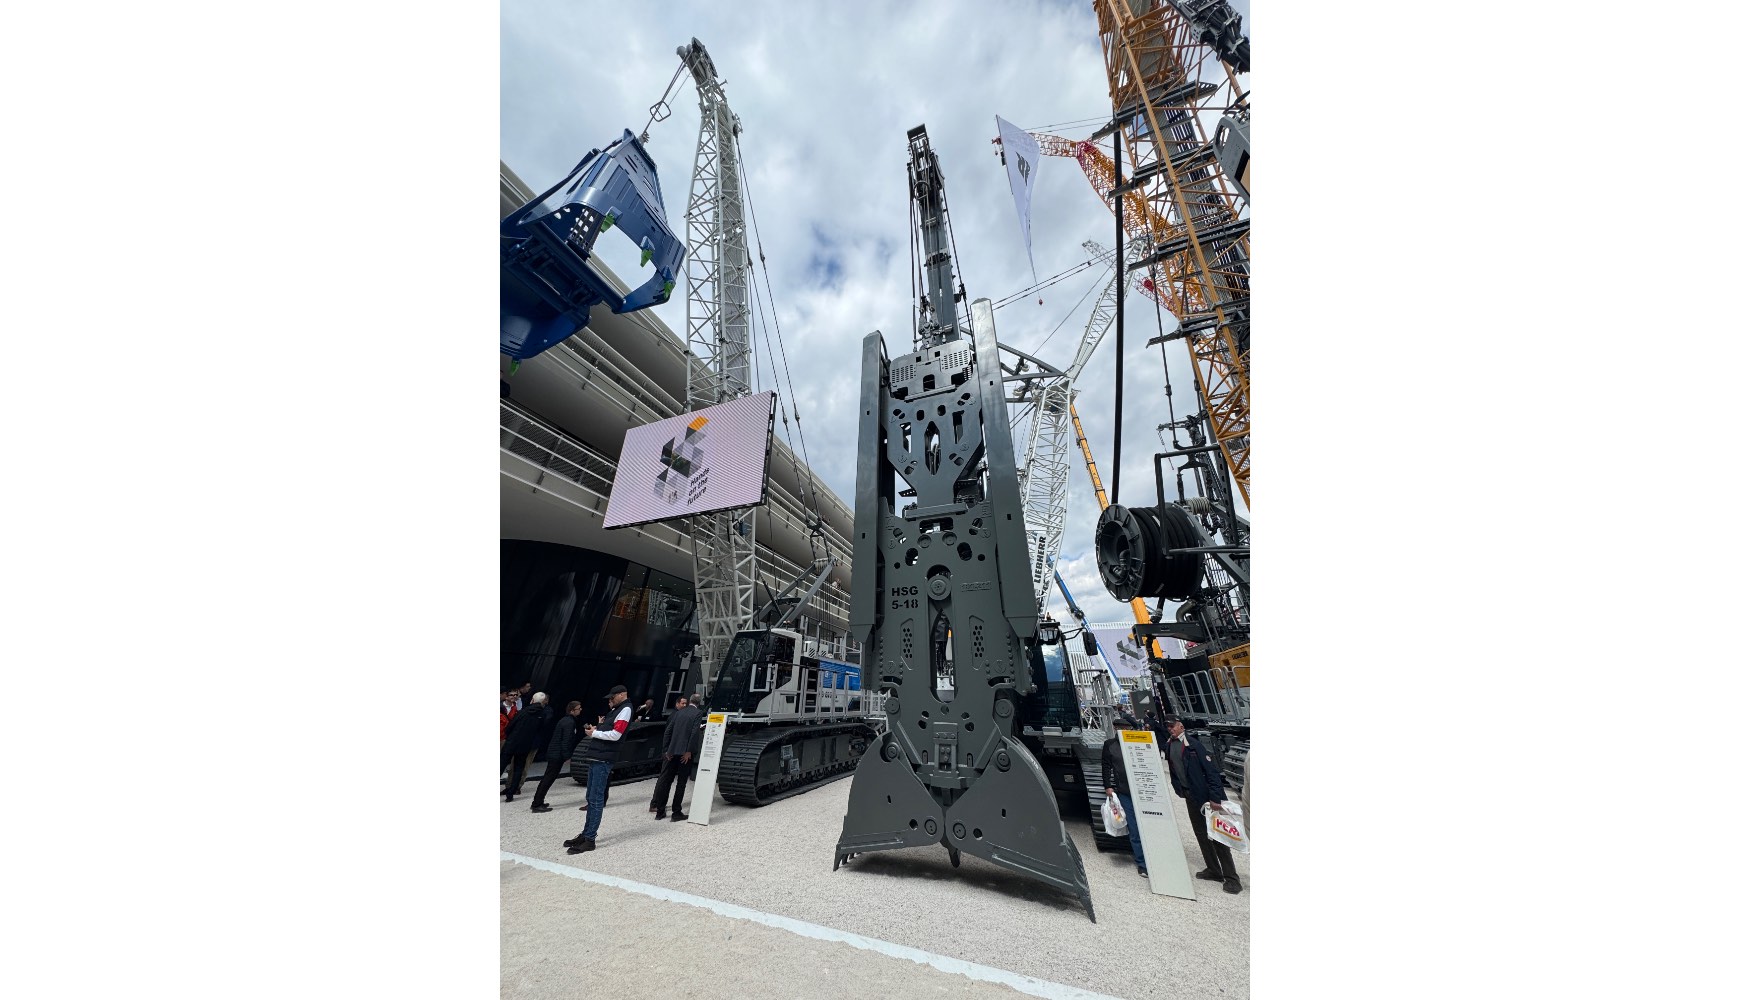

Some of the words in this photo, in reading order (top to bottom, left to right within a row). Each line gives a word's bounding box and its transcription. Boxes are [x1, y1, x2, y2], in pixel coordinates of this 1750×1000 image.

[690, 467, 709, 486] Hands
[687, 486, 707, 506] future
[689, 487, 697, 496] on
[698, 477, 708, 489] the
[1033, 536, 1047, 584] LIEBHERR
[891, 585, 919, 597] HSG
[891, 599, 919, 610] 5-18
